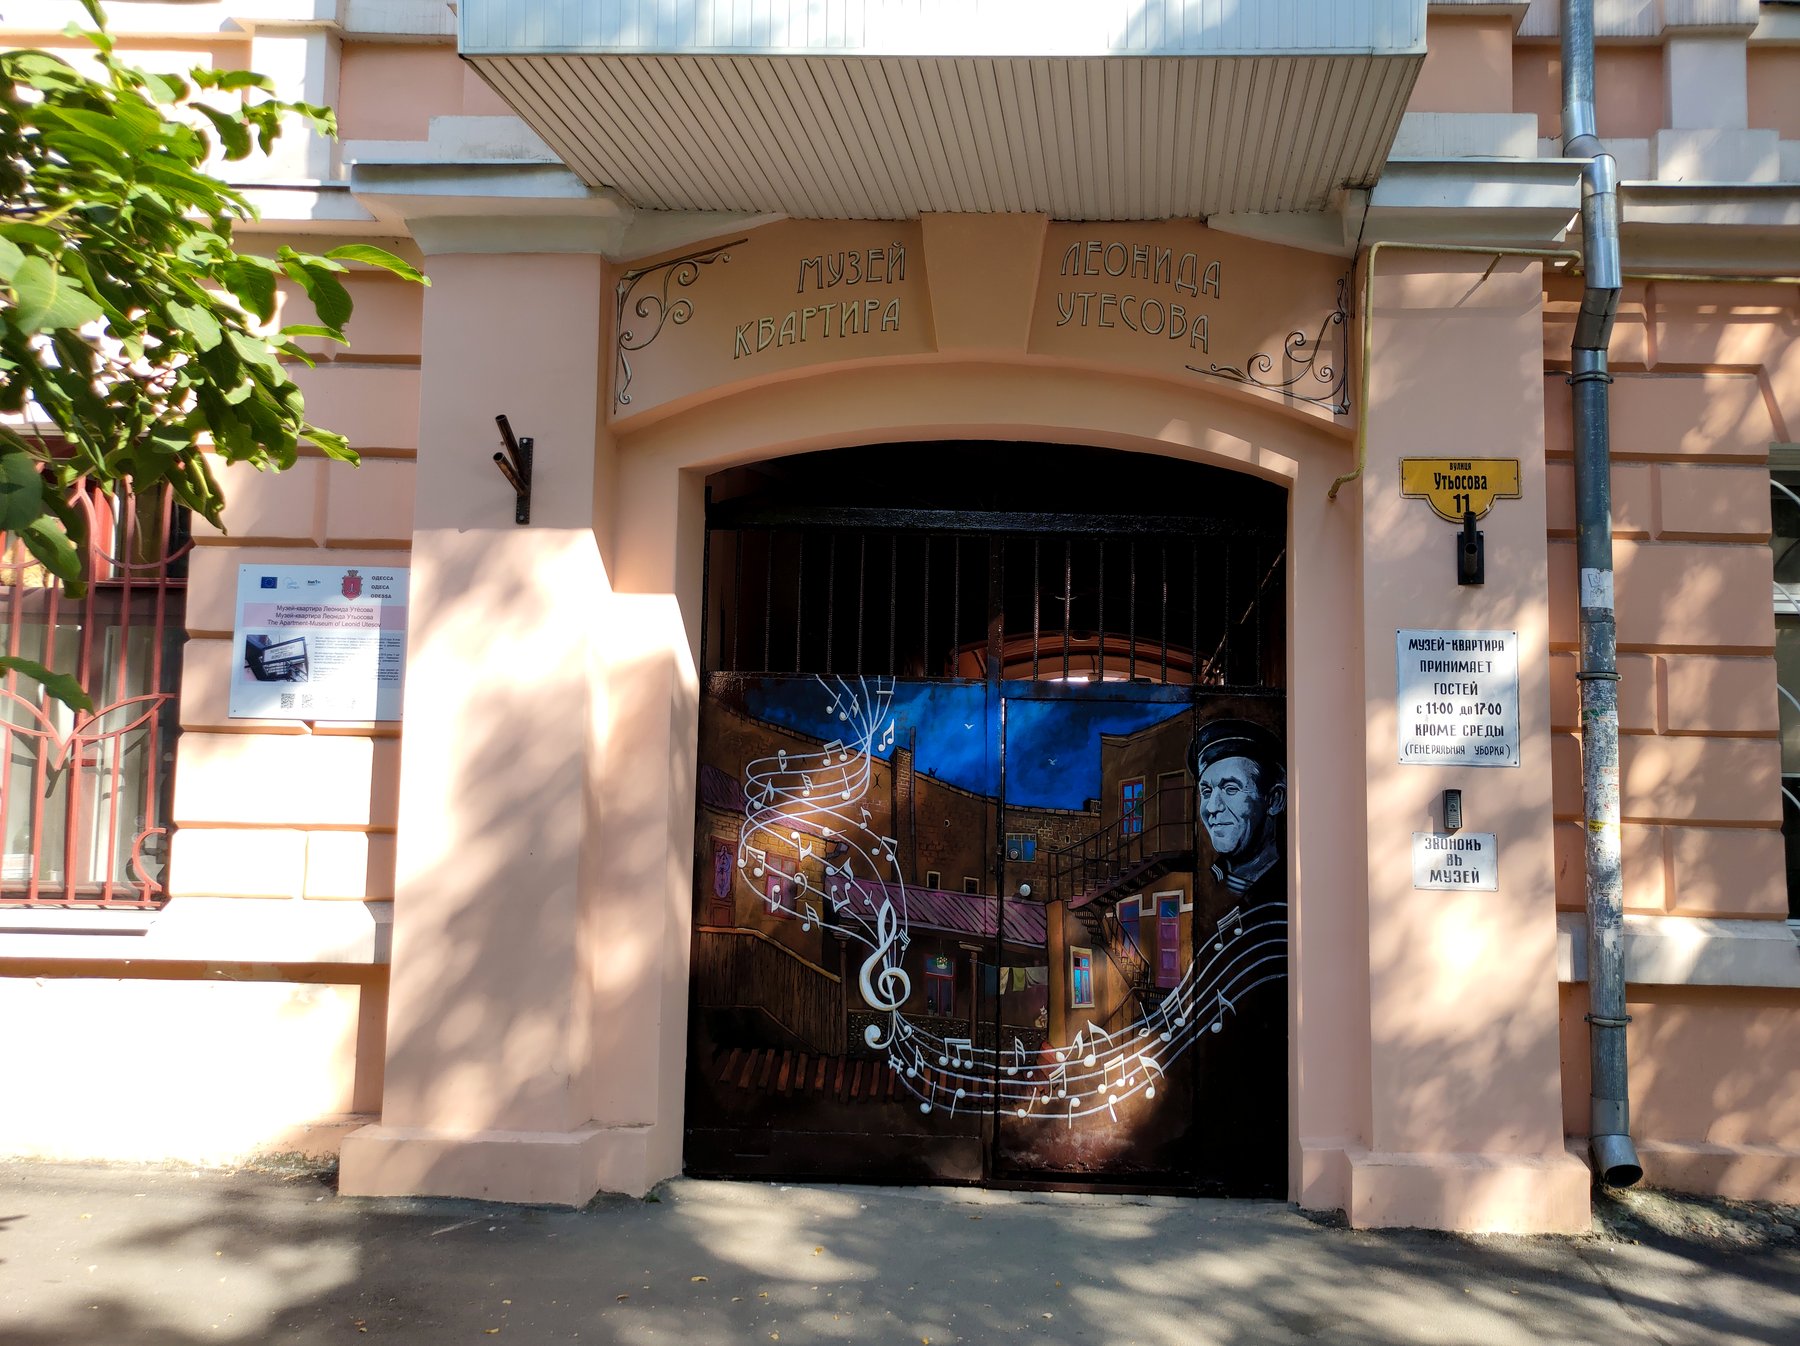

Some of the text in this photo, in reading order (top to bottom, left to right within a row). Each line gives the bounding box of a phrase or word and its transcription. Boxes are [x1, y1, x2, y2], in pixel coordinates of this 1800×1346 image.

[797, 240, 906, 293] МУЗЕЙ
[1061, 240, 1222, 299] ЛЕОНИДА
[733, 298, 900, 360] КВАРТИРА
[1056, 292, 1210, 354] УТЕСОВА
[1433, 472, 1488, 490] Утьосова
[1453, 493, 1470, 513] 11
[279, 619, 334, 627] Apartment-Museum
[1408, 637, 1504, 651] МУЗЕЙ-КВАРТИРА
[1420, 660, 1493, 673] ПРИНИМАЕТ
[1434, 681, 1479, 695] ГОСТЕЙ
[1415, 724, 1504, 738] КРОМЕ СРЕДЫ
[1430, 867, 1480, 883] МУЗЕЙ
